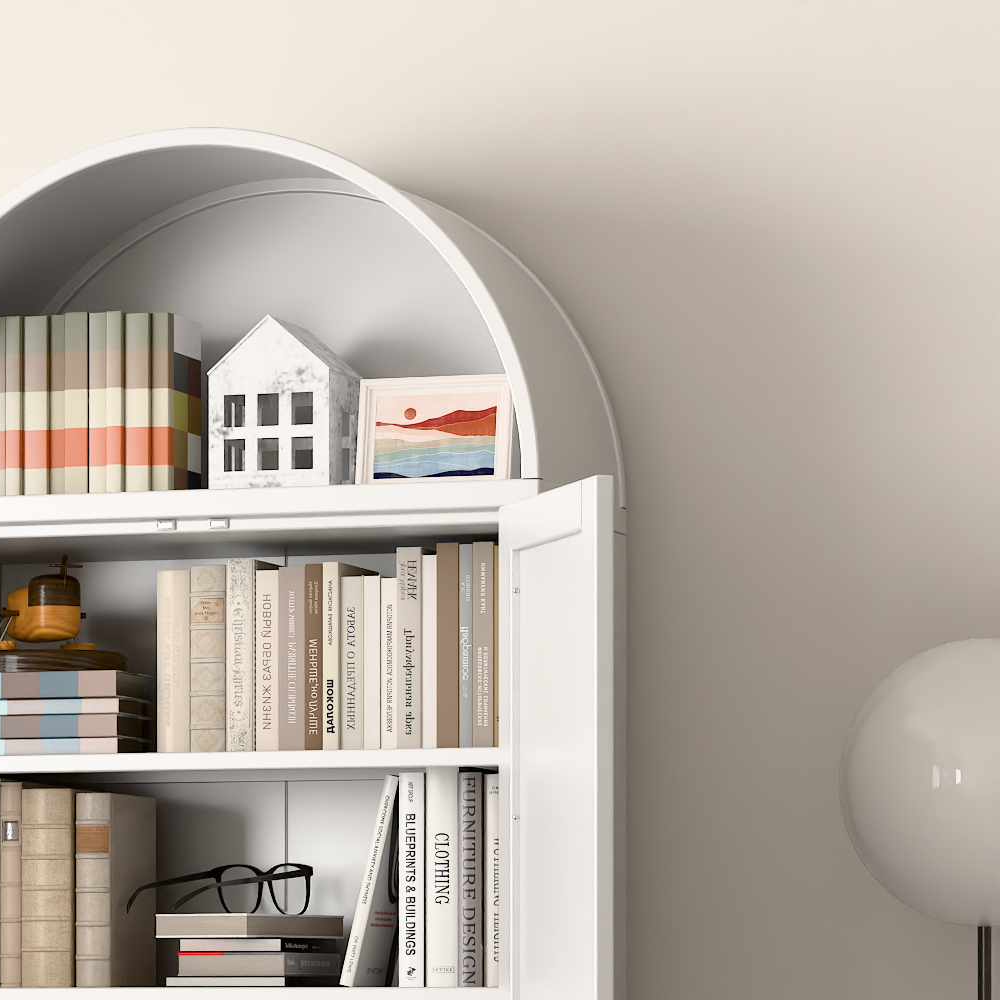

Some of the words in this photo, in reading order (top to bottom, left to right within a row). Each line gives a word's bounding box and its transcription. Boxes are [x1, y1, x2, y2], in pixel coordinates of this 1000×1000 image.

[406, 813, 416, 882] BLUEPRINTS
[434, 833, 449, 904] CLOTHING
[462, 776, 476, 900] FURNITURE
[406, 897, 416, 955] BUILDINGS
[462, 906, 476, 984] DESIGN
